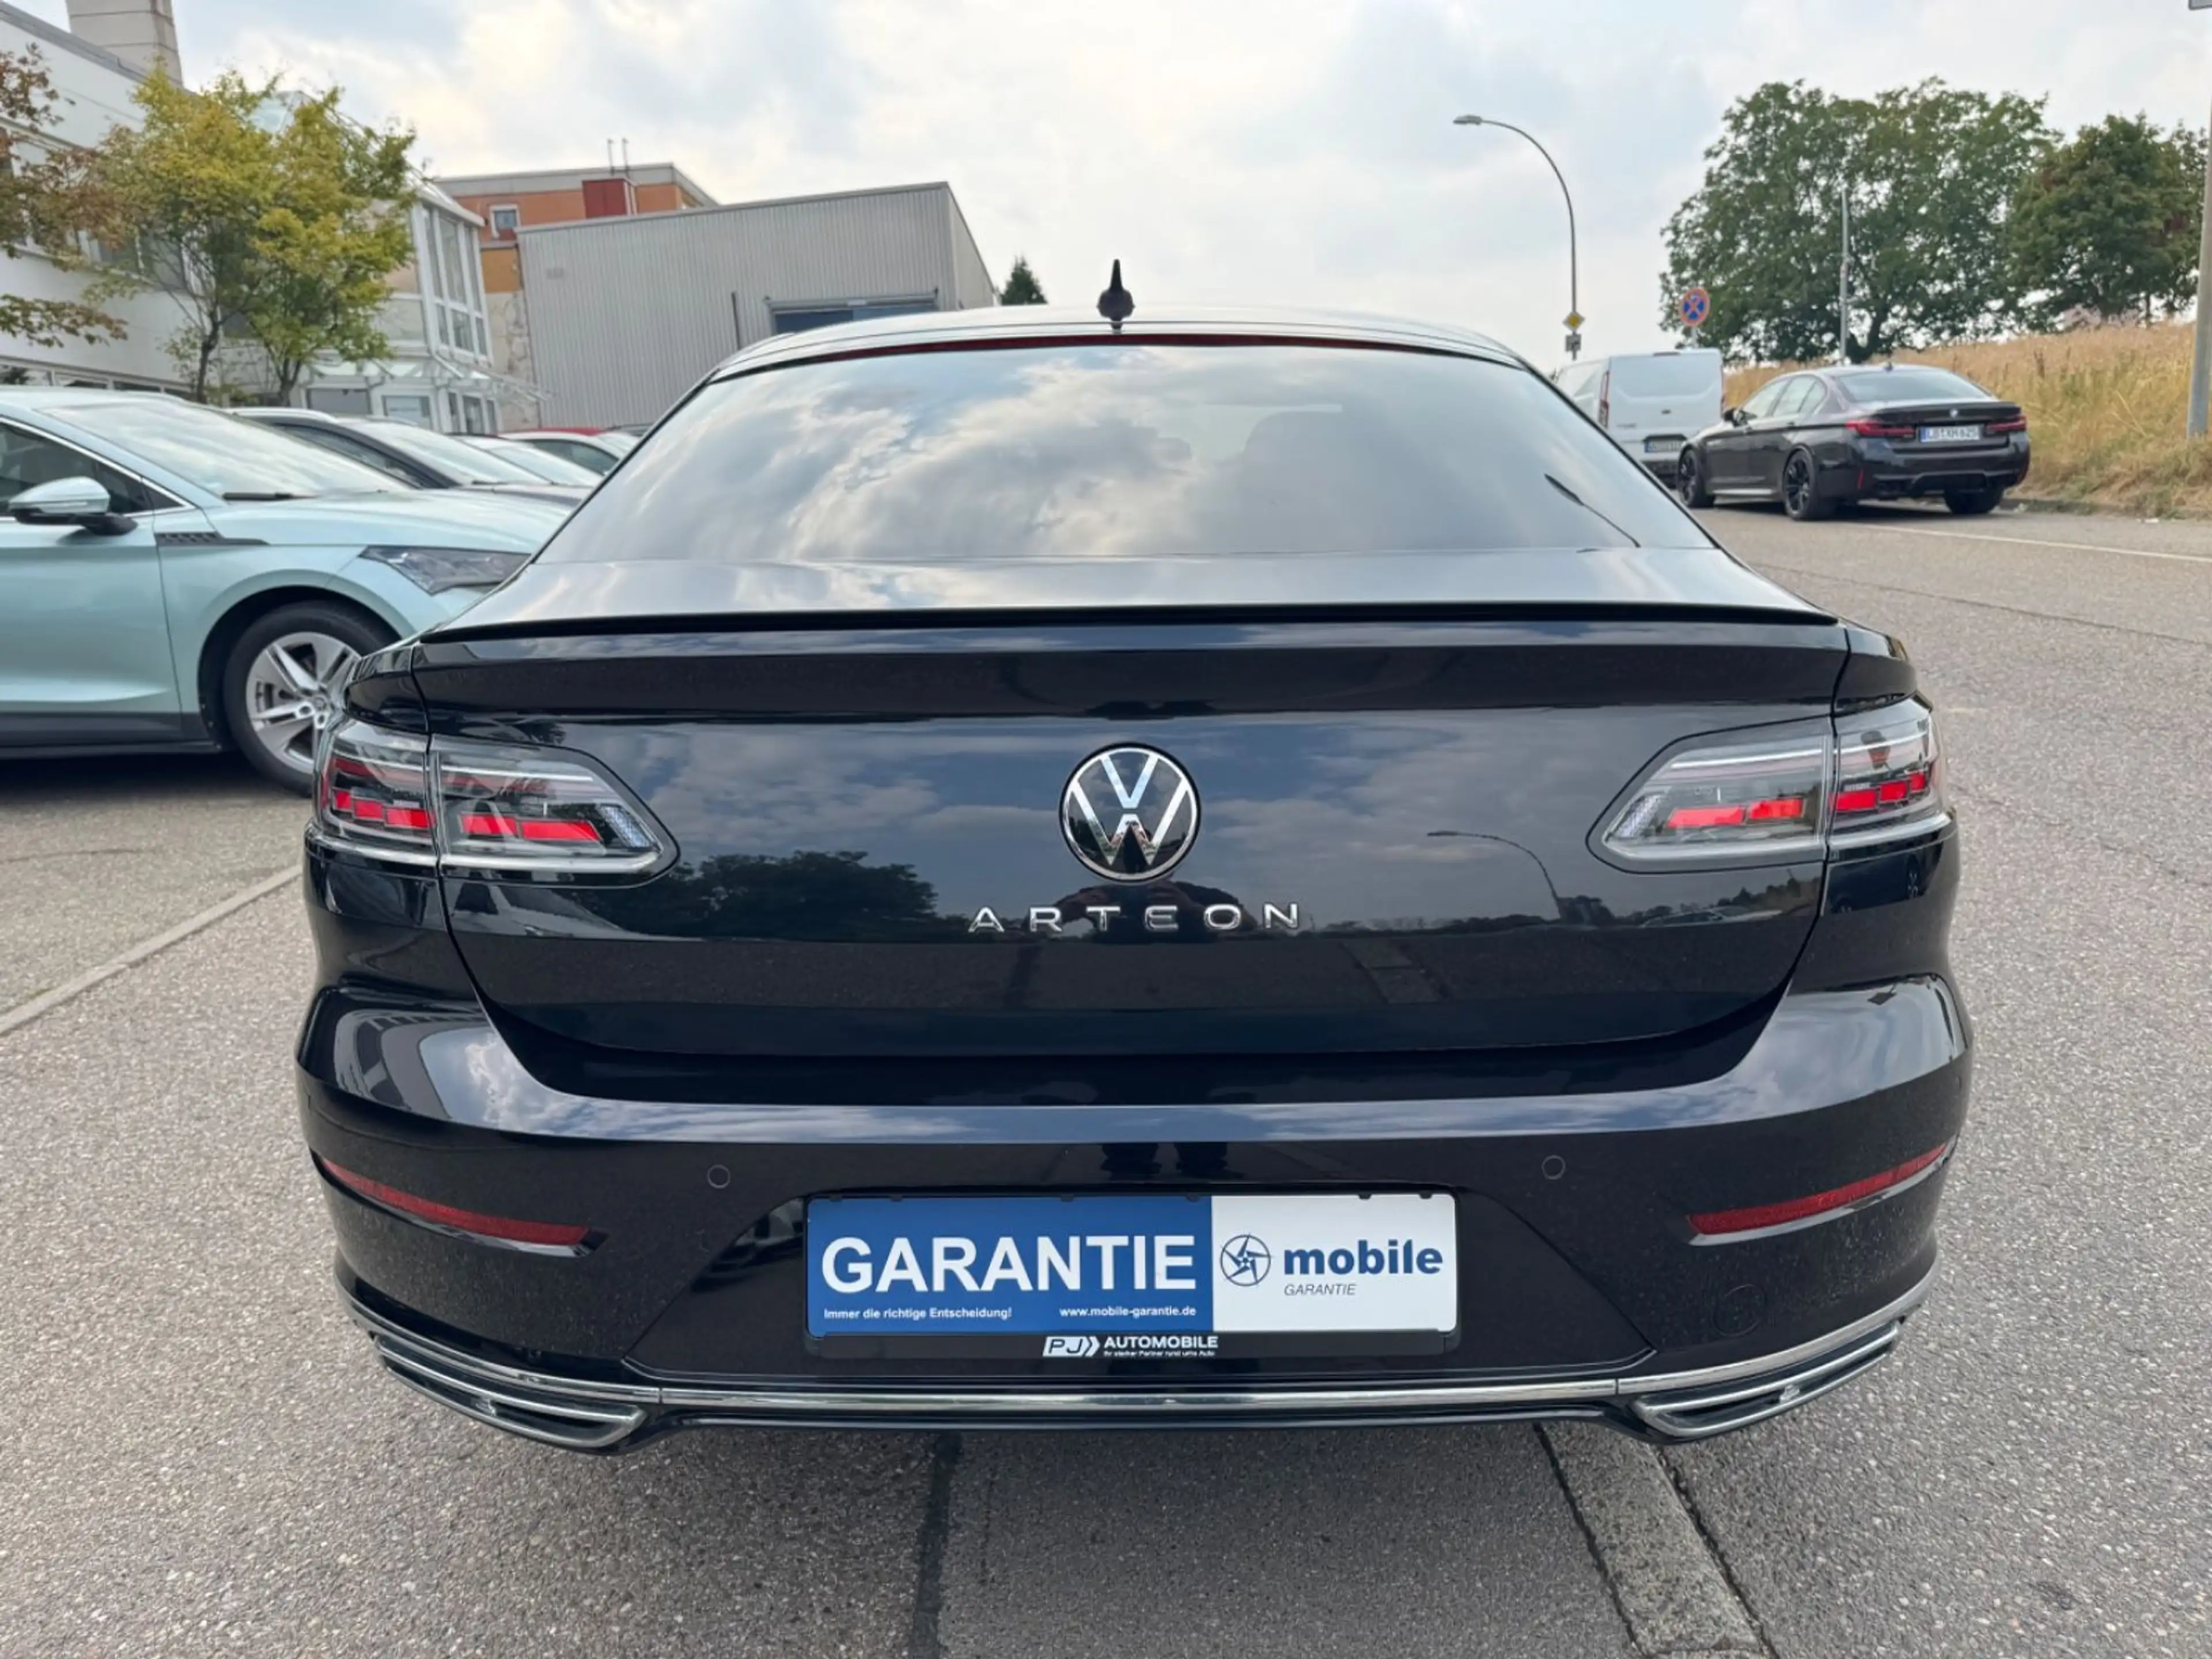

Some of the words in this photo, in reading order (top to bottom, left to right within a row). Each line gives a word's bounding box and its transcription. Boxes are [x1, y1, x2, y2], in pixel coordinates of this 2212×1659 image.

[968, 903, 1298, 933] ARTEON
[1283, 1239, 1443, 1275] mobile
[821, 1236, 1196, 1293] GARANTIE
[1284, 1283, 1357, 1296] GARANTIE
[824, 1308, 860, 1319] Immer
[863, 1308, 880, 1319] die
[883, 1308, 926, 1321] richtige
[929, 1307, 1012, 1321] Entscheidung!
[1059, 1305, 1196, 1319] www.mobile-garantie.de
[1104, 1336, 1218, 1348] AUTOMOBILE
